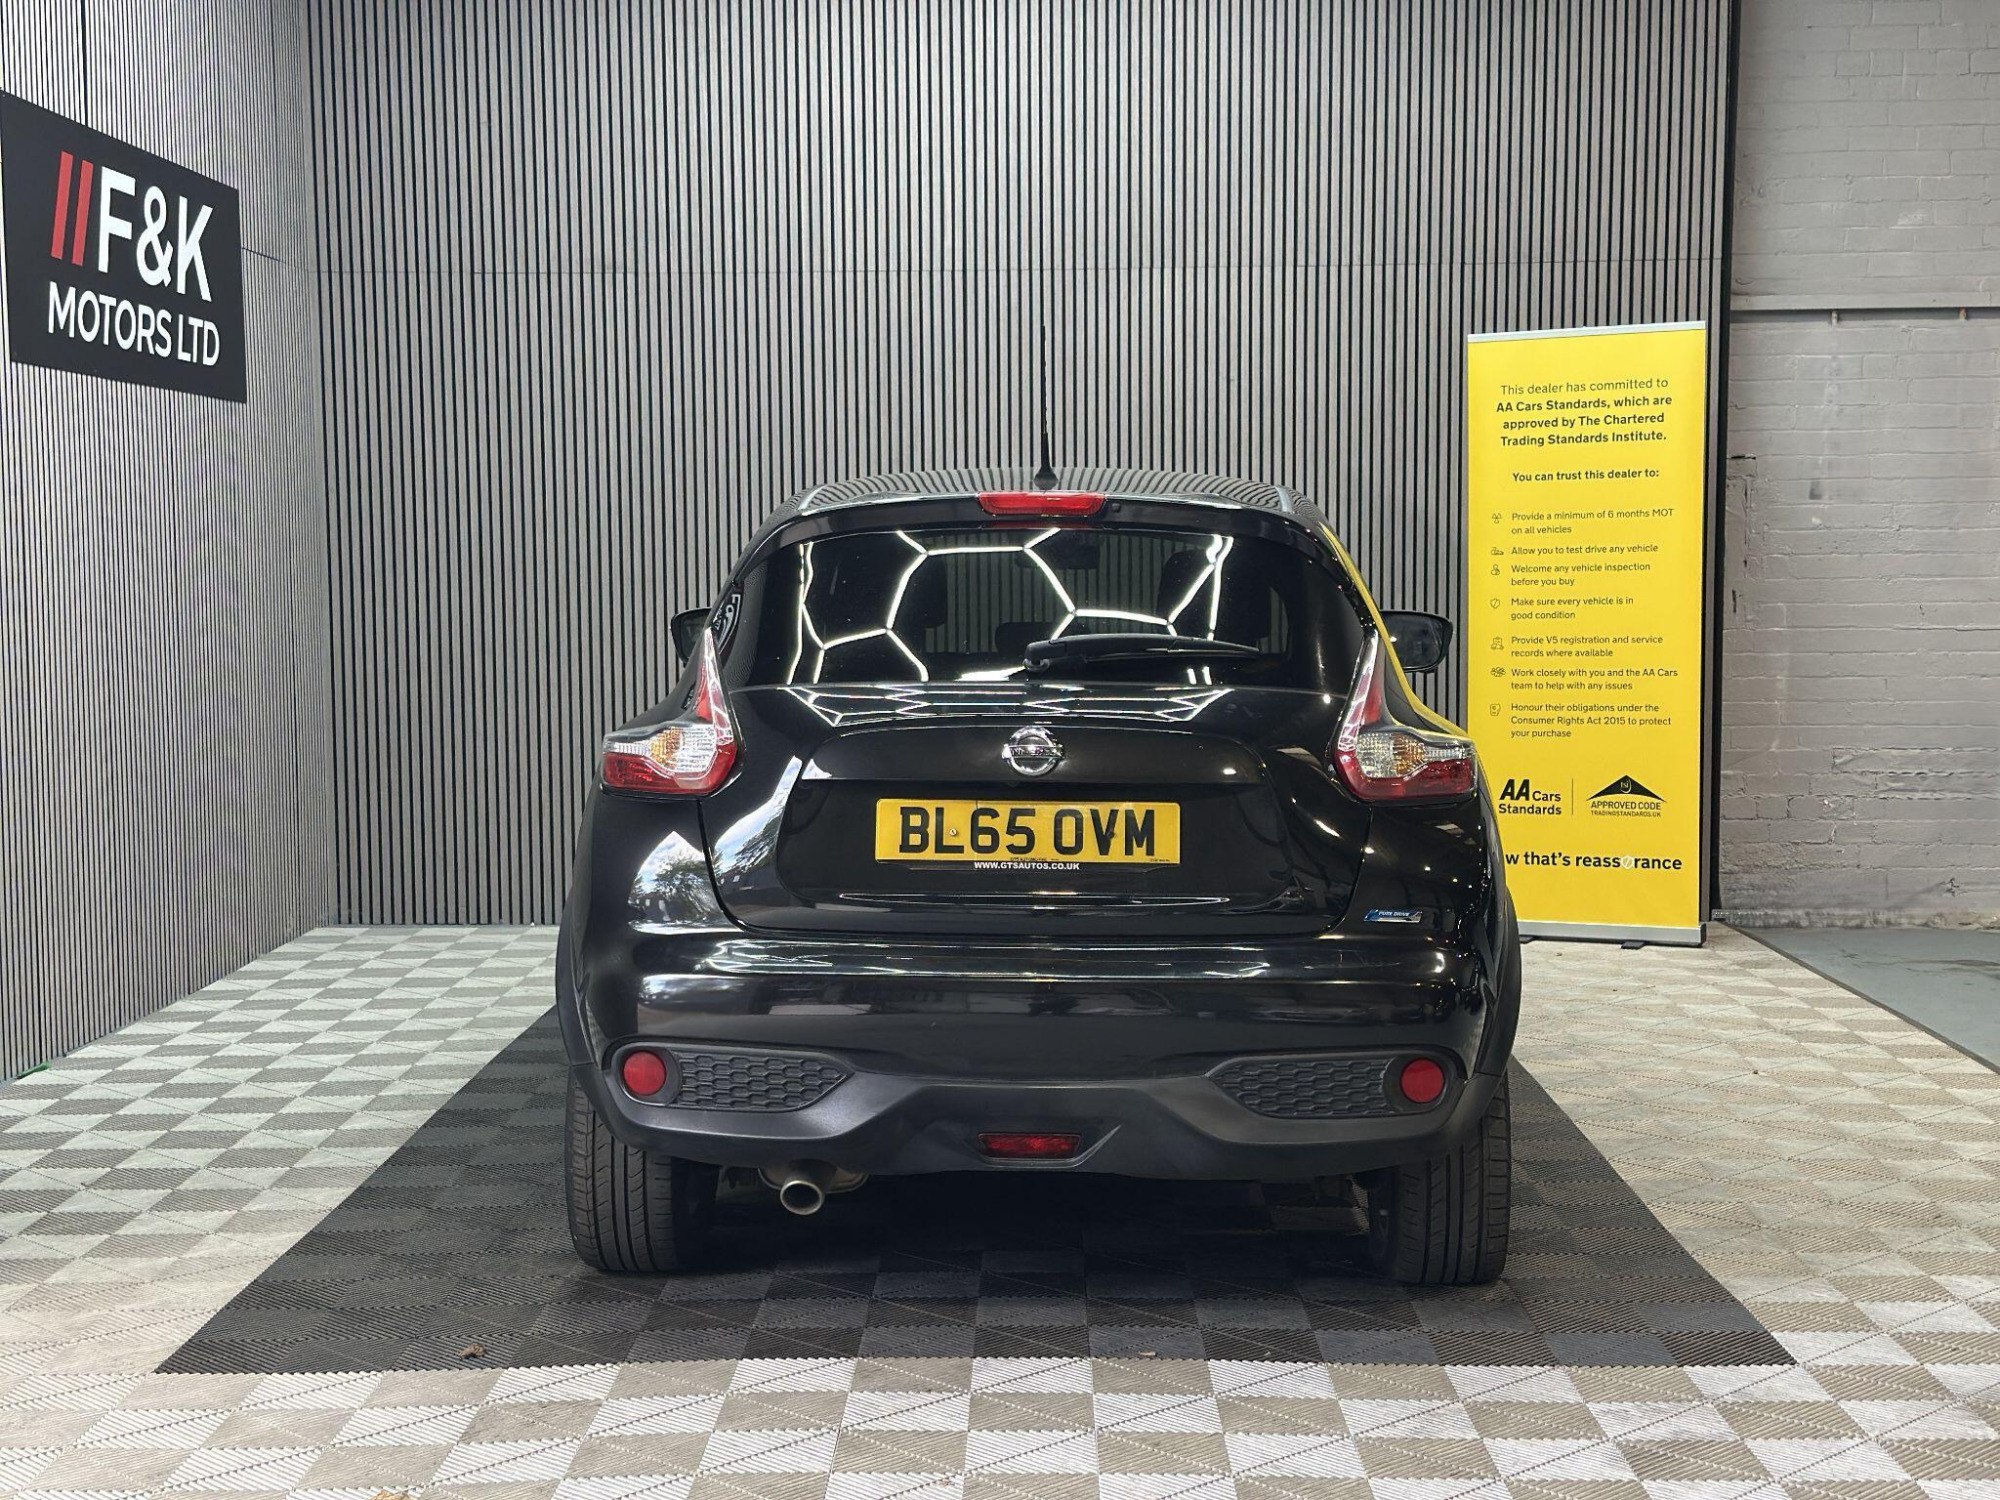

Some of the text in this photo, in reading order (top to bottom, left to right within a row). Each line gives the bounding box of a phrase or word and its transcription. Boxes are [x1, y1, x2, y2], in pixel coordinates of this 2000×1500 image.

[99, 166, 213, 302] F&K
[48, 281, 220, 366] MOTORS LTD
[1501, 378, 1668, 395] This dealer has committed to
[1496, 396, 1672, 412] AA Cars Standards, which are
[1503, 412, 1664, 430] approved by The Chartered
[1501, 430, 1667, 447] Trading Standards Institute.
[1512, 469, 1659, 481] You can trust this dealer to:
[1512, 512, 1545, 521] Provide
[1554, 511, 1594, 520] minimum
[1597, 511, 1607, 519] of
[1608, 510, 1614, 518] 6
[1616, 509, 1650, 518] months
[1652, 508, 1674, 517] MOT
[1524, 526, 1535, 534] all
[1537, 525, 1572, 534] vehicles
[1511, 544, 1658, 556] Allow you to test drive any vehicle
[1511, 563, 1651, 574] Welcome any vehicle inspection
[1541, 579, 1557, 587] you
[1559, 578, 1575, 586] buy
[1511, 598, 1534, 606] Make
[1557, 598, 1581, 607] every
[1583, 597, 1614, 605] vehicle
[1511, 610, 1575, 621] good condition
[1511, 635, 1663, 645] Provide V5 registration and service
[1511, 648, 1613, 657] records where available
[1511, 668, 1678, 678] Work closely with you and the AA Cars
[1511, 682, 1633, 692] team to help with any issues
[1511, 703, 1659, 713] Honour their obligations under the
[1511, 716, 1671, 727] Consumer Rights Act 2015 to protect
[1511, 729, 1572, 739] your purchase
[1500, 779, 1561, 802] AA Cars
[1499, 804, 1562, 815] Standards
[1591, 801, 1661, 810] APPROVED CODE
[899, 806, 1155, 856] BL65 OVM
[974, 861, 1080, 870] WWW.GTSAUTOS.CO.UK
